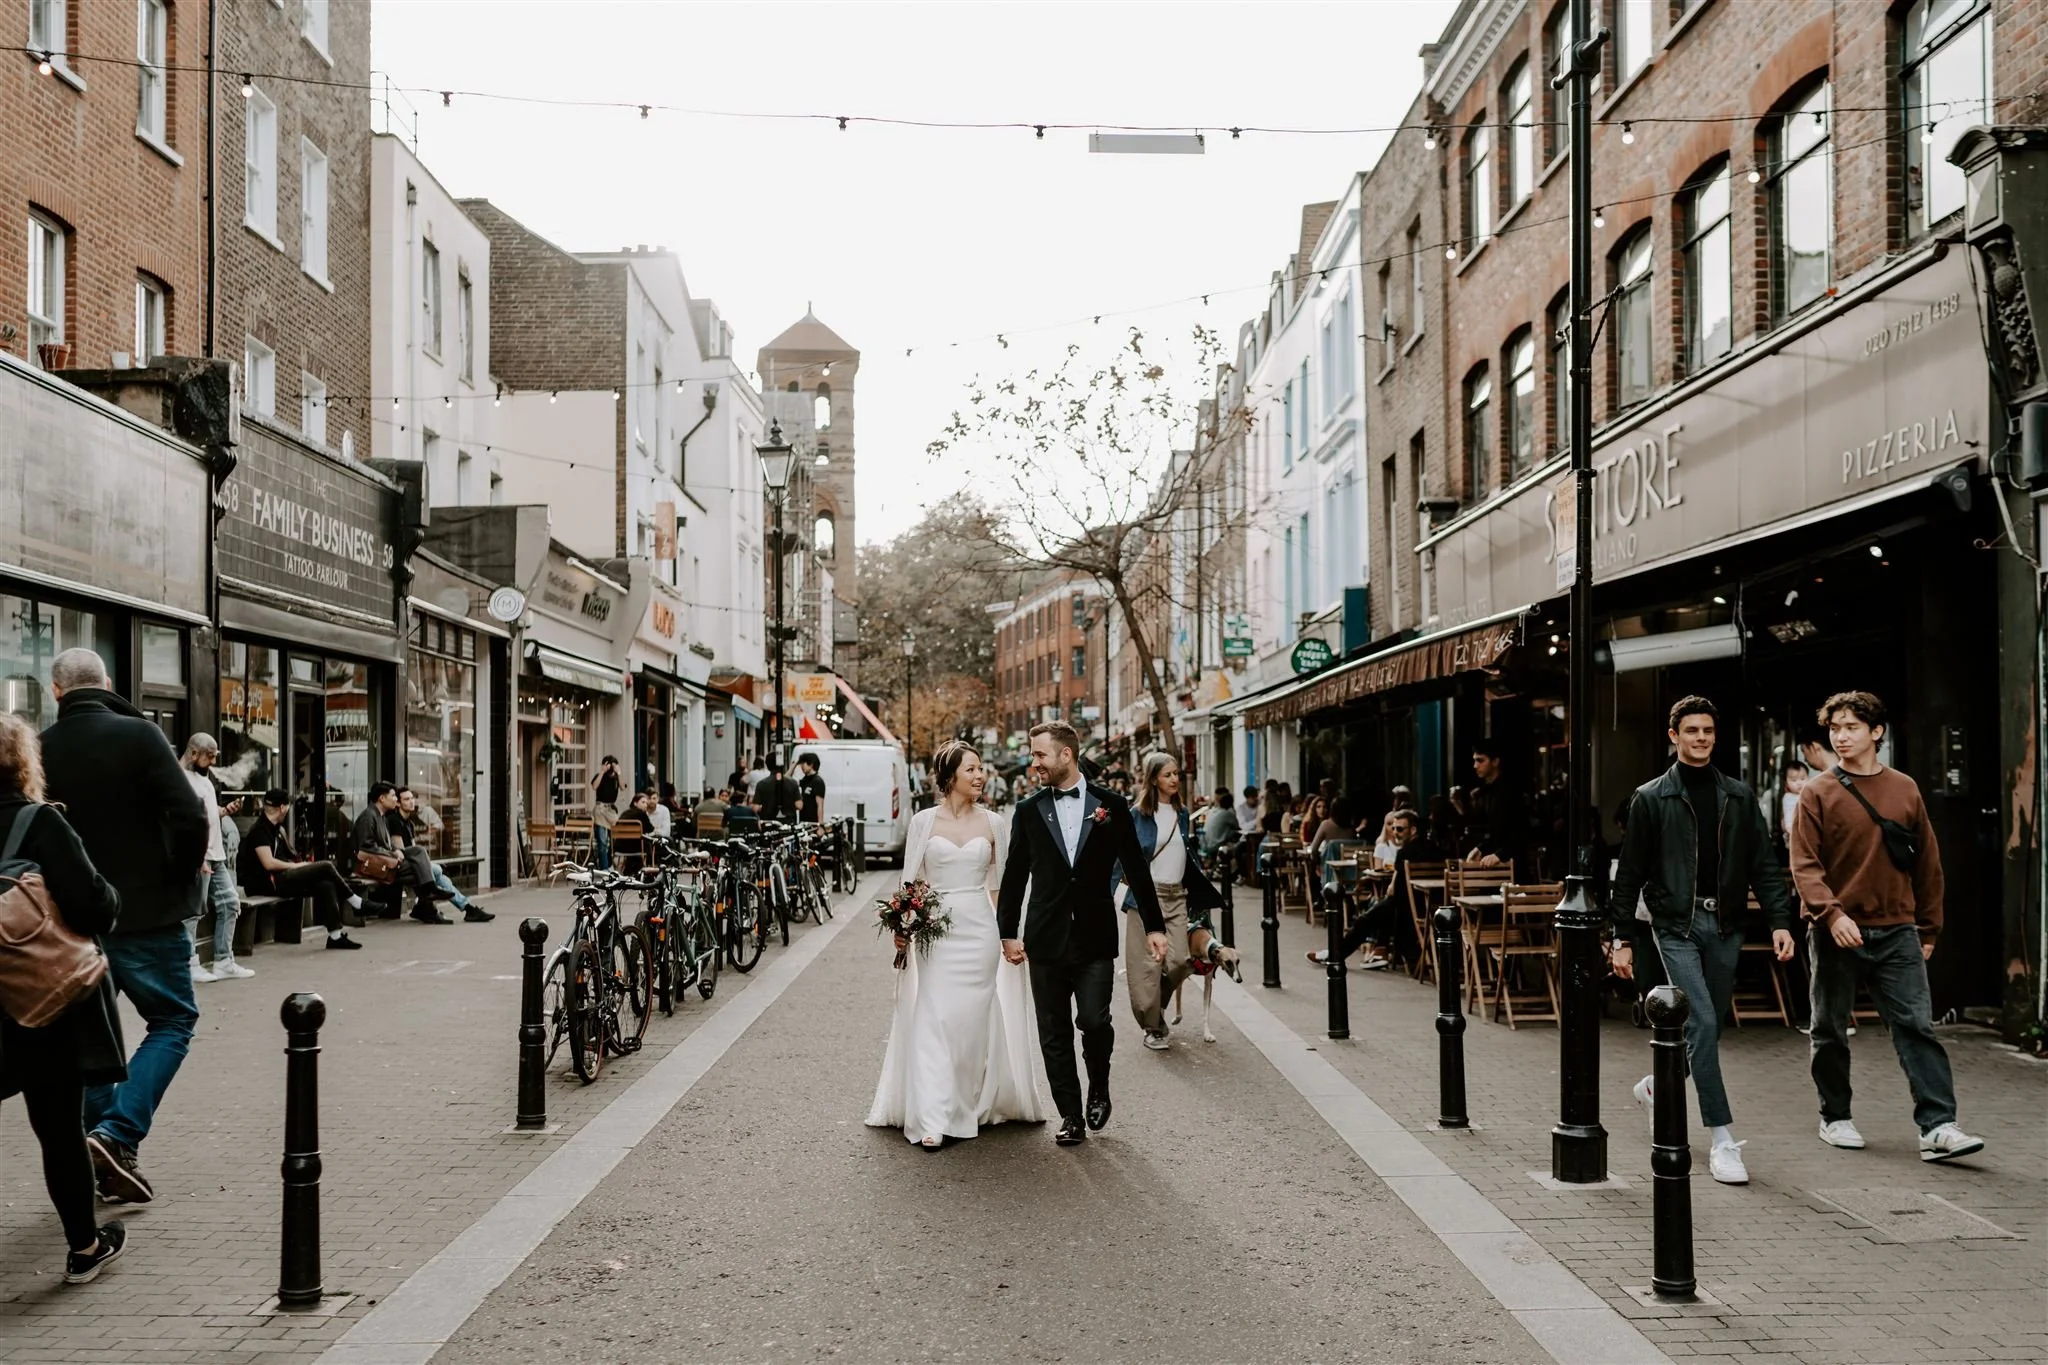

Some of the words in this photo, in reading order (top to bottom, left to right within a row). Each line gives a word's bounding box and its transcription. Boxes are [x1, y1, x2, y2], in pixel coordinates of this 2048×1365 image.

[1864, 328, 1890, 356] 020
[1894, 311, 1923, 342] 7812
[1843, 408, 1960, 484] PIZZERIA
[312, 479, 327, 498] THE
[1545, 422, 1684, 564] STORE
[252, 488, 309, 541] FAMILY
[312, 511, 375, 567] BUSINESS
[284, 554, 314, 579] TATTOO
[316, 565, 348, 590] PARLOUR
[382, 543, 394, 569] 58
